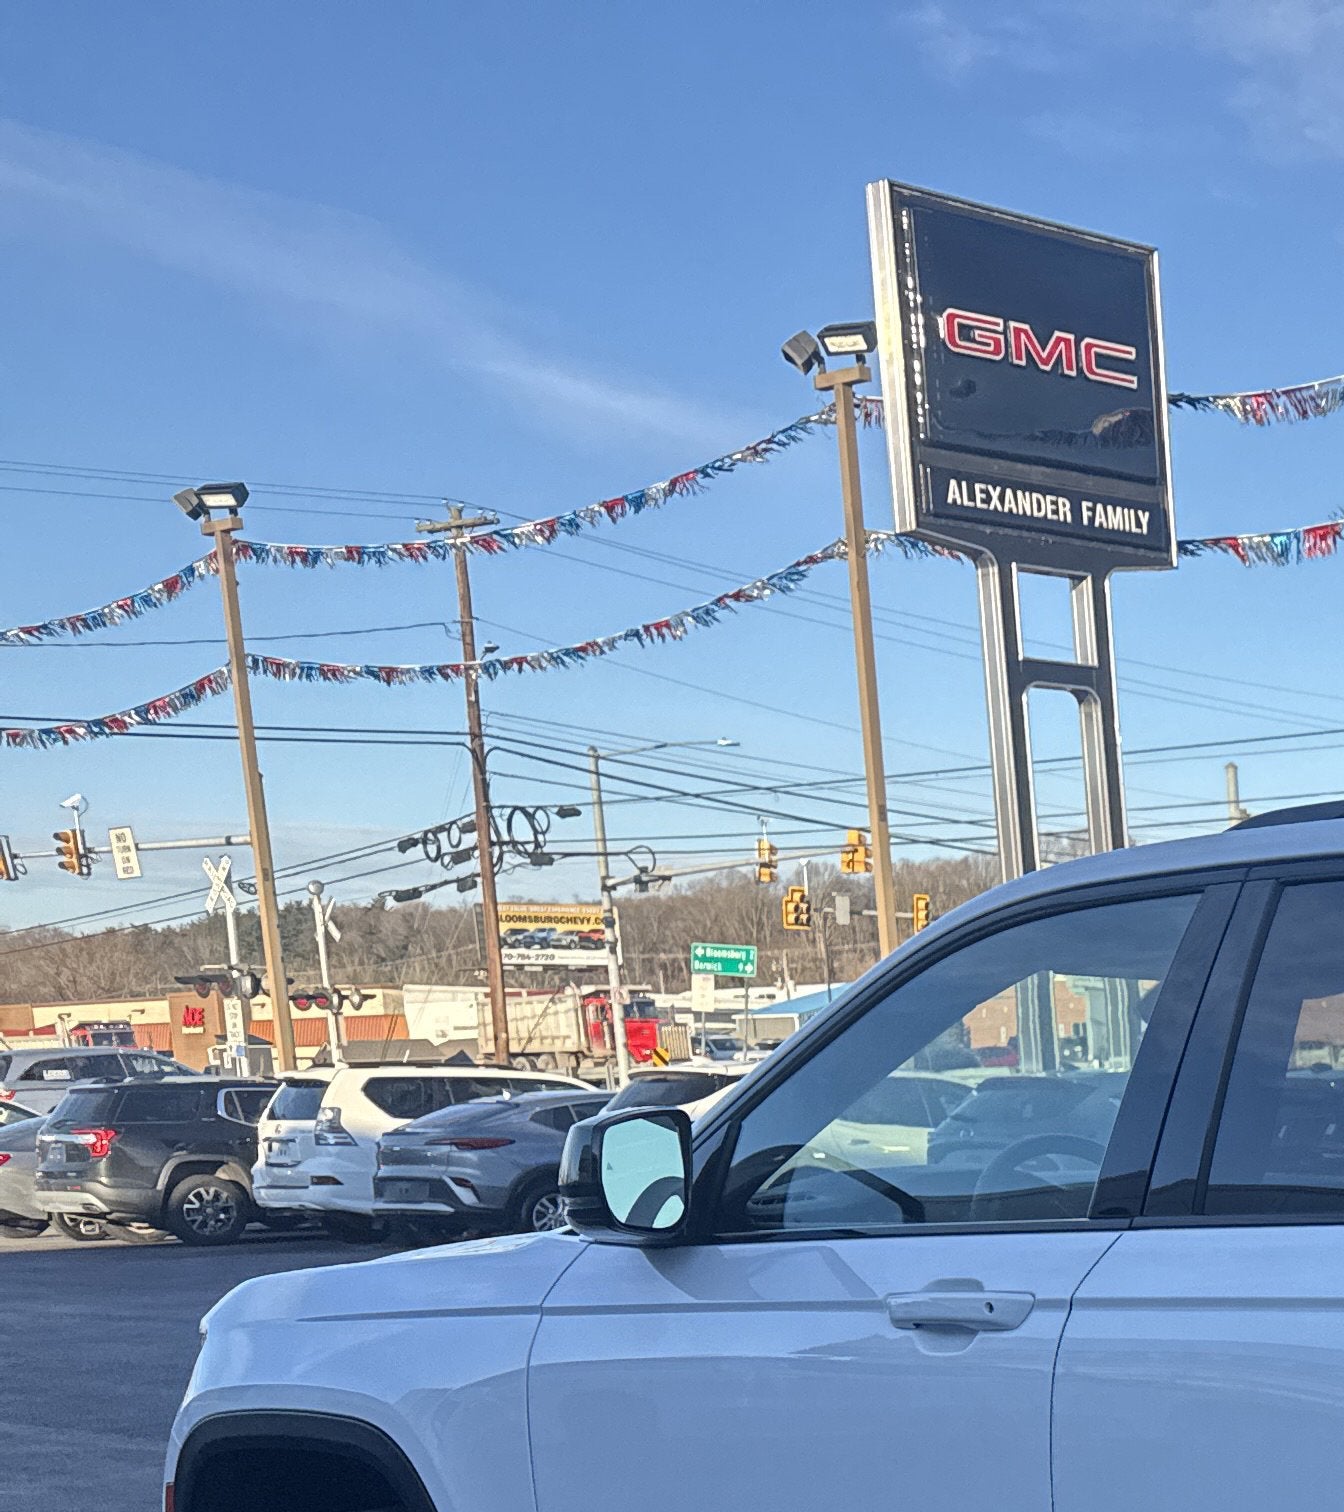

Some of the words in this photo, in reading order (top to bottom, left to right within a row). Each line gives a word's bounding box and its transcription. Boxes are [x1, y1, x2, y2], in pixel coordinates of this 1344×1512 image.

[942, 307, 1139, 390] GMC
[946, 478, 1073, 524] ALEXANDER
[1082, 500, 1151, 535] FAMILY
[182, 1007, 205, 1028] ACE
